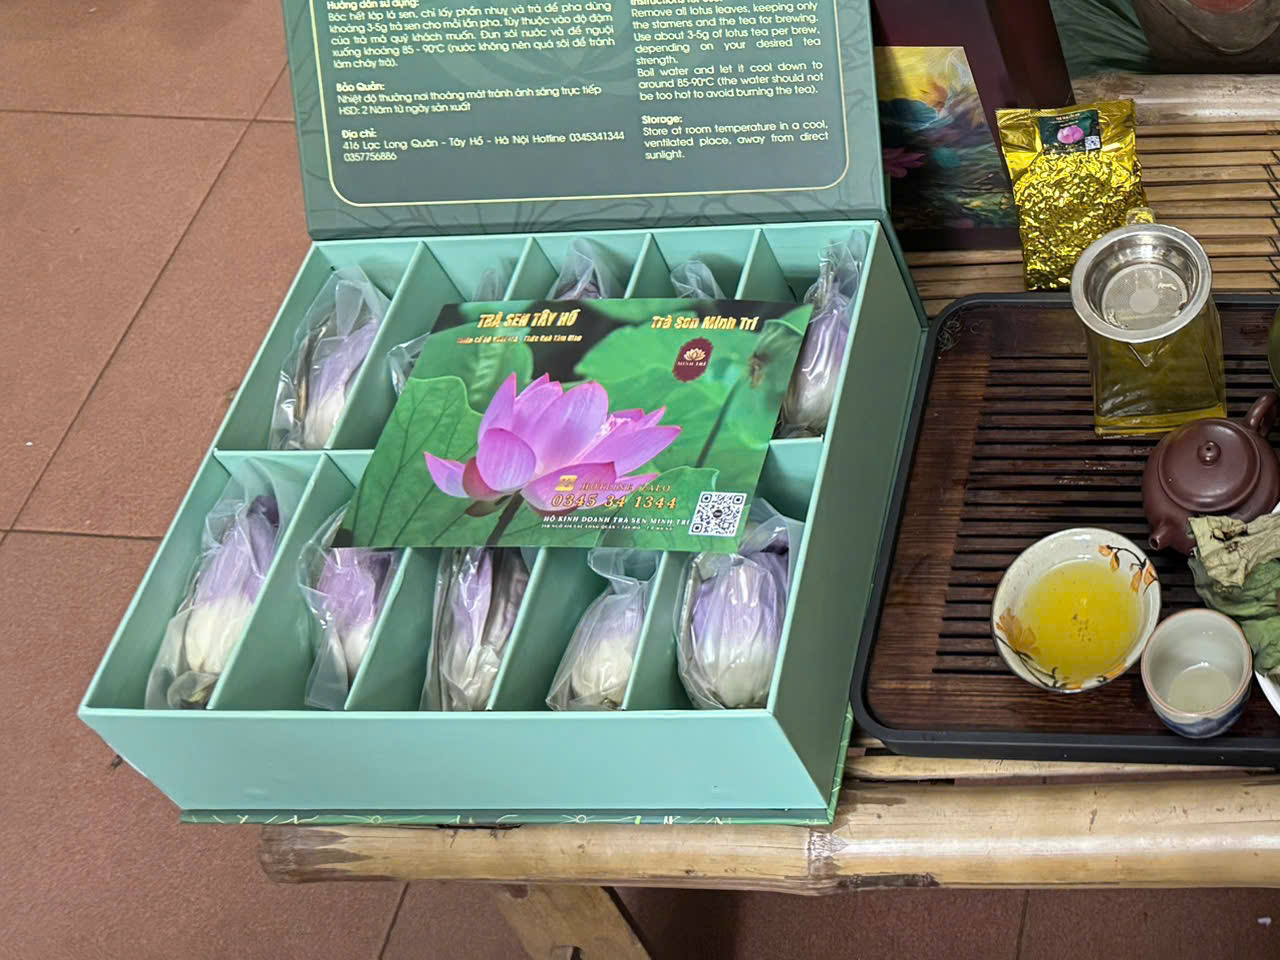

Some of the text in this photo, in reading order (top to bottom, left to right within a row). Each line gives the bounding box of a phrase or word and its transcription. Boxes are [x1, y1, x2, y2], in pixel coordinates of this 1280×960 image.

[631, 1, 818, 17] Remove all lotus keeping only
[651, 20, 693, 28] stamens
[695, 17, 716, 26] and
[718, 17, 735, 25] the
[738, 16, 756, 25] tea
[758, 15, 772, 24] for
[633, 32, 651, 41] Use
[654, 31, 684, 40] about
[725, 28, 748, 37] lotus
[750, 28, 768, 36] tea
[771, 28, 788, 37] per
[634, 43, 690, 54] depending
[723, 42, 745, 50] your
[756, 38, 793, 48] desired
[803, 37, 821, 46] tea
[637, 68, 654, 76] Boil
[659, 65, 688, 75] water
[693, 65, 714, 74] and
[719, 64, 732, 73] let
[749, 62, 772, 72] cool
[777, 62, 806, 71] down
[638, 78, 674, 88] around
[740, 75, 769, 84] water
[771, 73, 804, 83] should
[807, 72, 823, 81] not
[655, 91, 672, 100] too
[674, 90, 691, 99] hot
[705, 88, 734, 98] avoid
[775, 86, 792, 94] the
[641, 115, 682, 125] Storage:
[643, 127, 668, 135] Store
[685, 126, 712, 134] room
[714, 122, 776, 135] temperature
[342, 139, 360, 149] 416
[383, 140, 408, 150] Long
[569, 131, 624, 142] 0345341344
[644, 131, 828, 147] ventilated away from direct
[343, 151, 397, 161] 0357756886
[552, 494, 678, 509] 0345 34 1344
